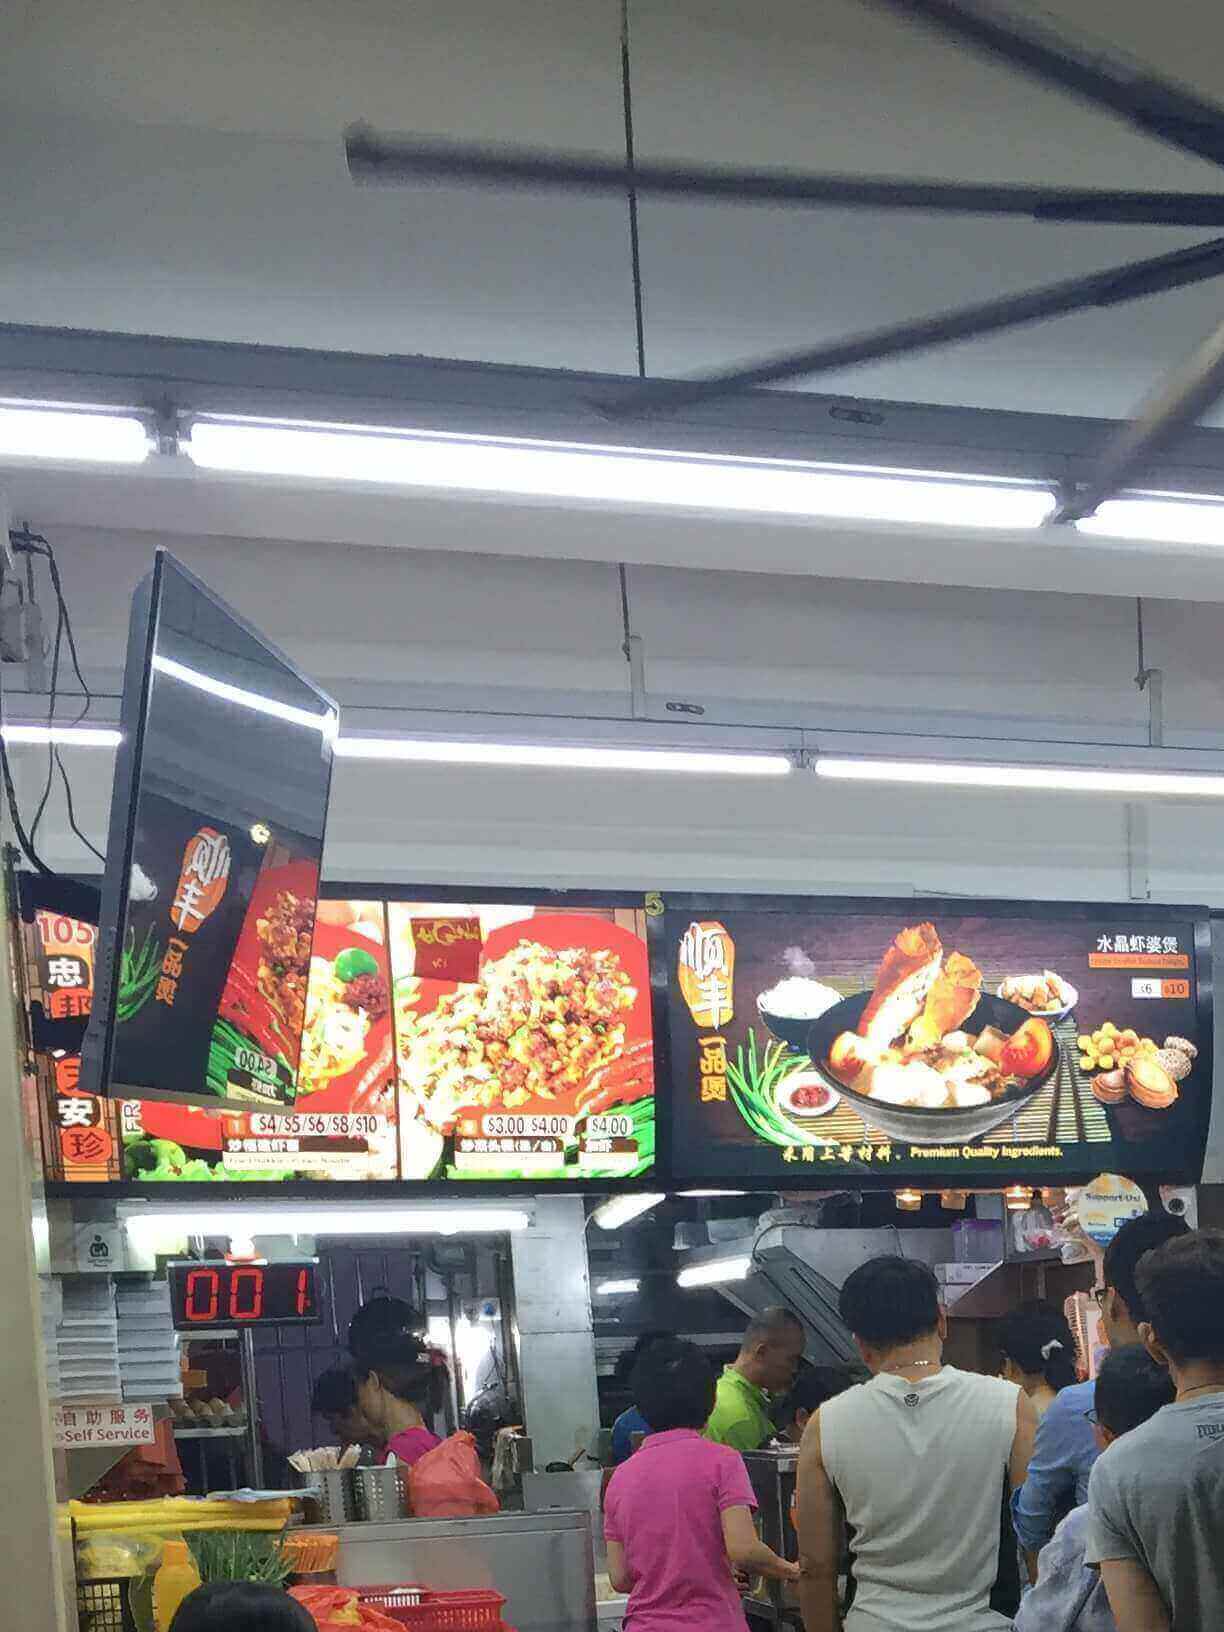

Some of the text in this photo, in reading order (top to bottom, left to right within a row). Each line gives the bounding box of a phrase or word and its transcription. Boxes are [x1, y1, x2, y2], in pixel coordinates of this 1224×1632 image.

[645, 892, 664, 916] 5
[38, 916, 94, 944] 105
[488, 1116, 568, 1135] $3.00 $4.00
[591, 1117, 628, 1135] $4.00
[910, 1146, 960, 1158] Premium
[962, 1146, 999, 1160] Quality
[185, 1268, 309, 1320] 001
[63, 1407, 150, 1426] 自助服务
[64, 1426, 150, 1442] Self Service
